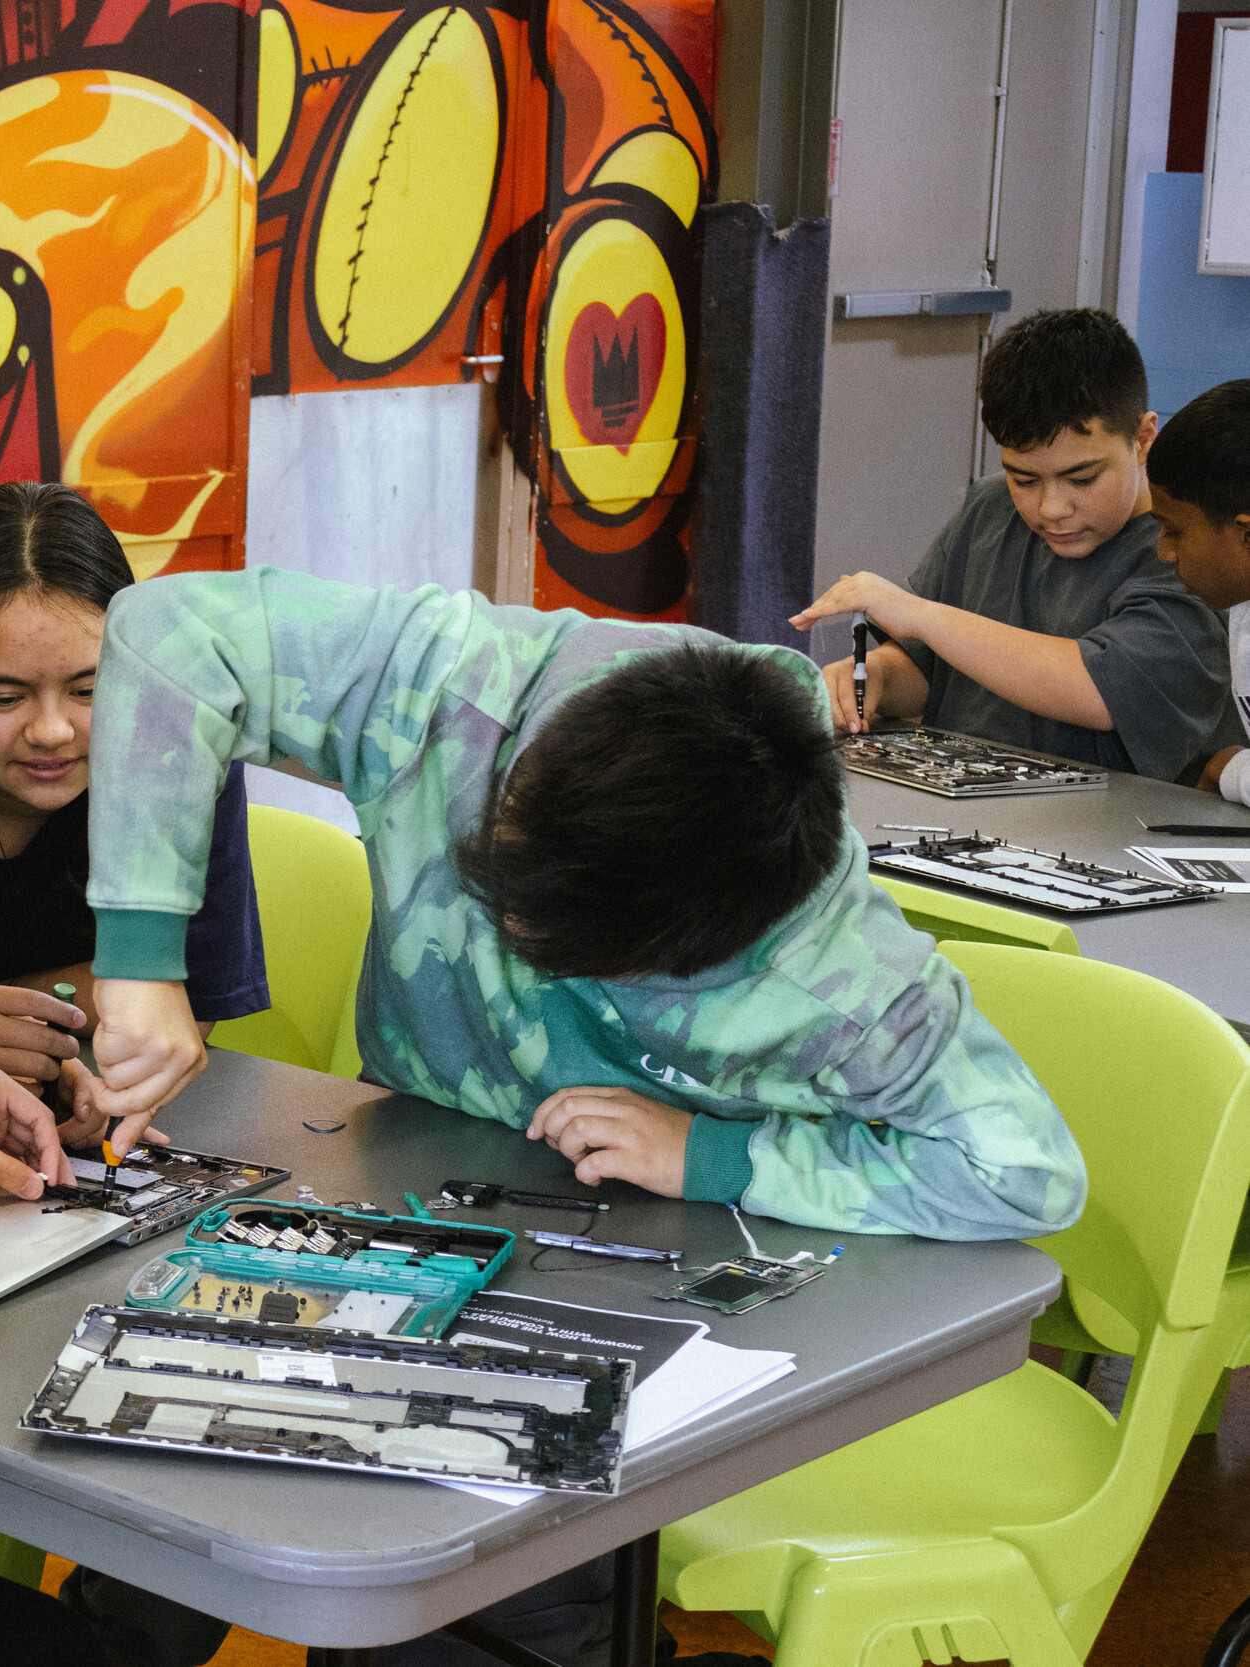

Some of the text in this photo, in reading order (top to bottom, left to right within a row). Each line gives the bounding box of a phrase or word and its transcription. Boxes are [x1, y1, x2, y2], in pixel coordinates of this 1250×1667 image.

[470, 1312, 545, 1330] COMPUTERS
[505, 1311, 554, 1325] Reference
[460, 1314, 645, 1351] SHOWING HOW THE BIOS AND
[558, 1329, 592, 1338] WITH
